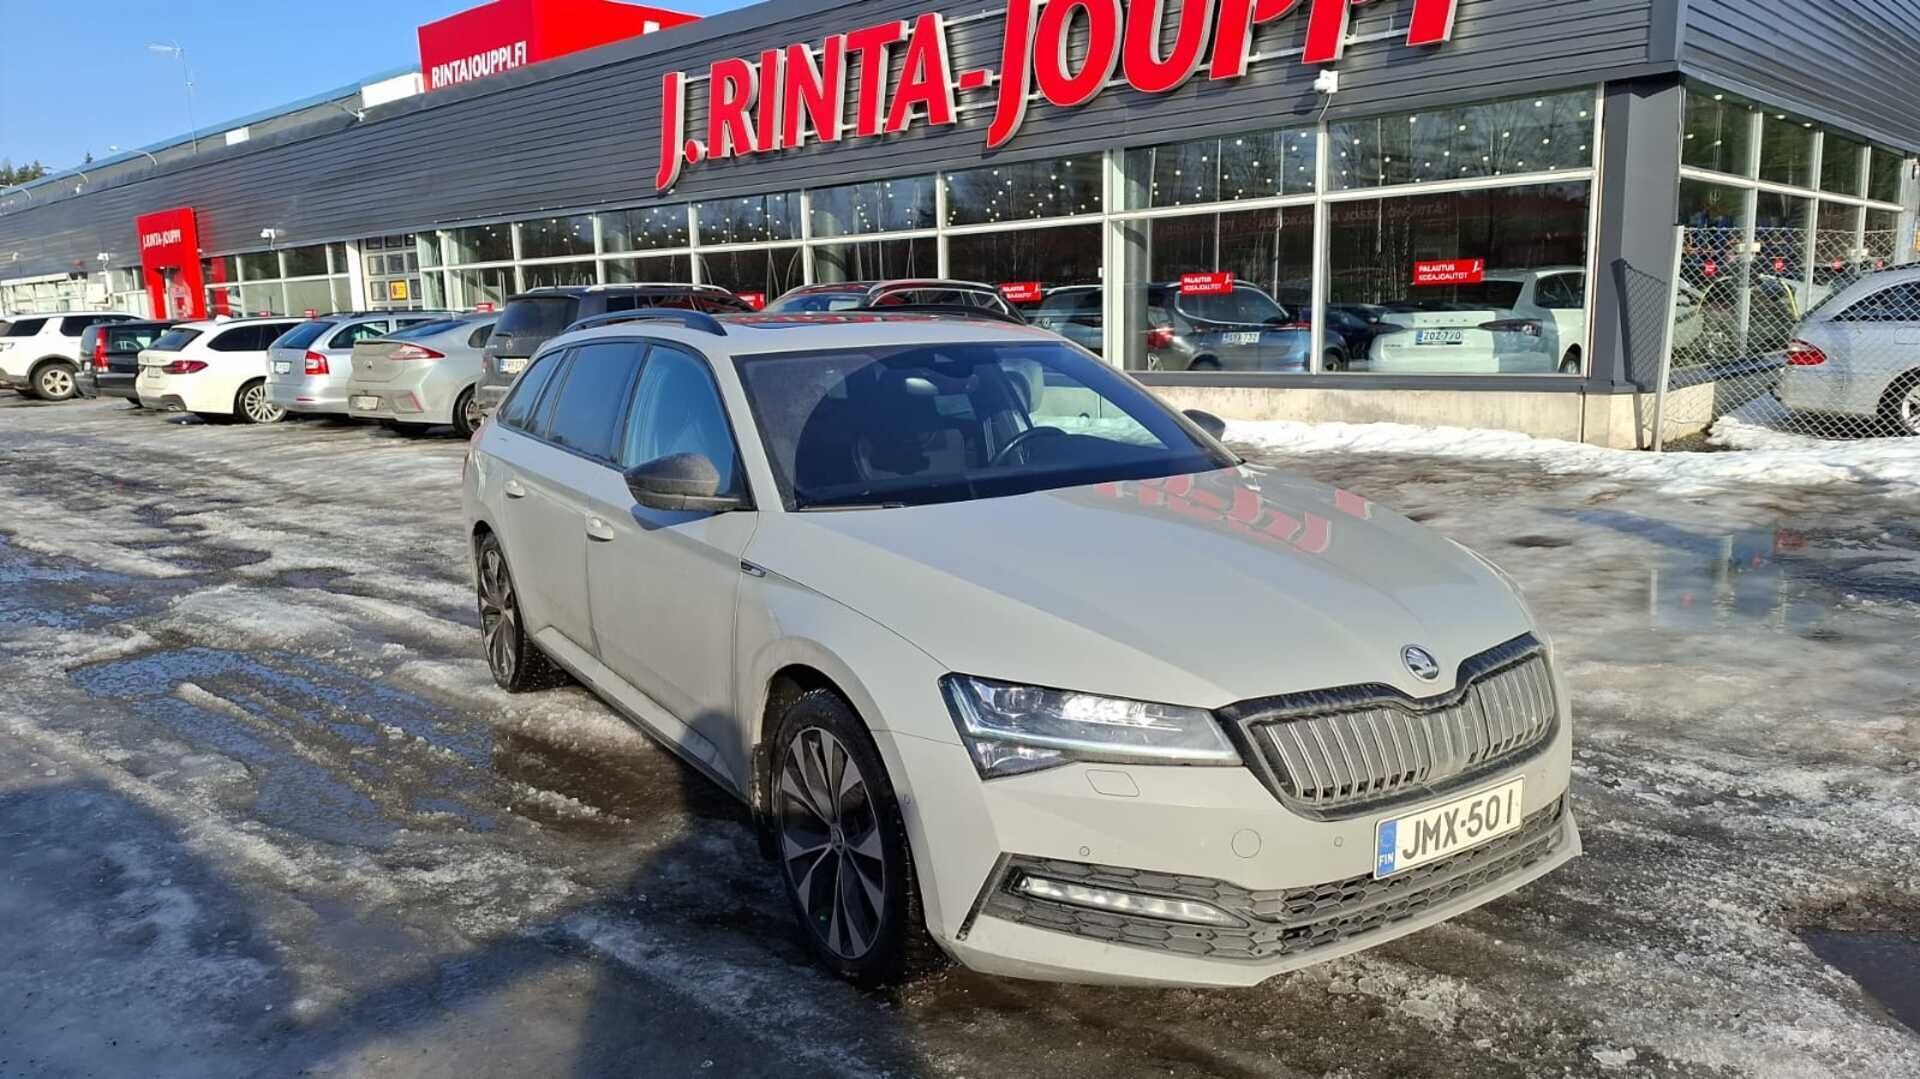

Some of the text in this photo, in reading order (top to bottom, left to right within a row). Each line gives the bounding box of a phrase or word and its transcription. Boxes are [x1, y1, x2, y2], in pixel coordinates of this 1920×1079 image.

[432, 40, 527, 89] RINTAJOUPPI.FI
[1402, 789, 1513, 860] JMX-501
[1379, 852, 1394, 866] FIN
